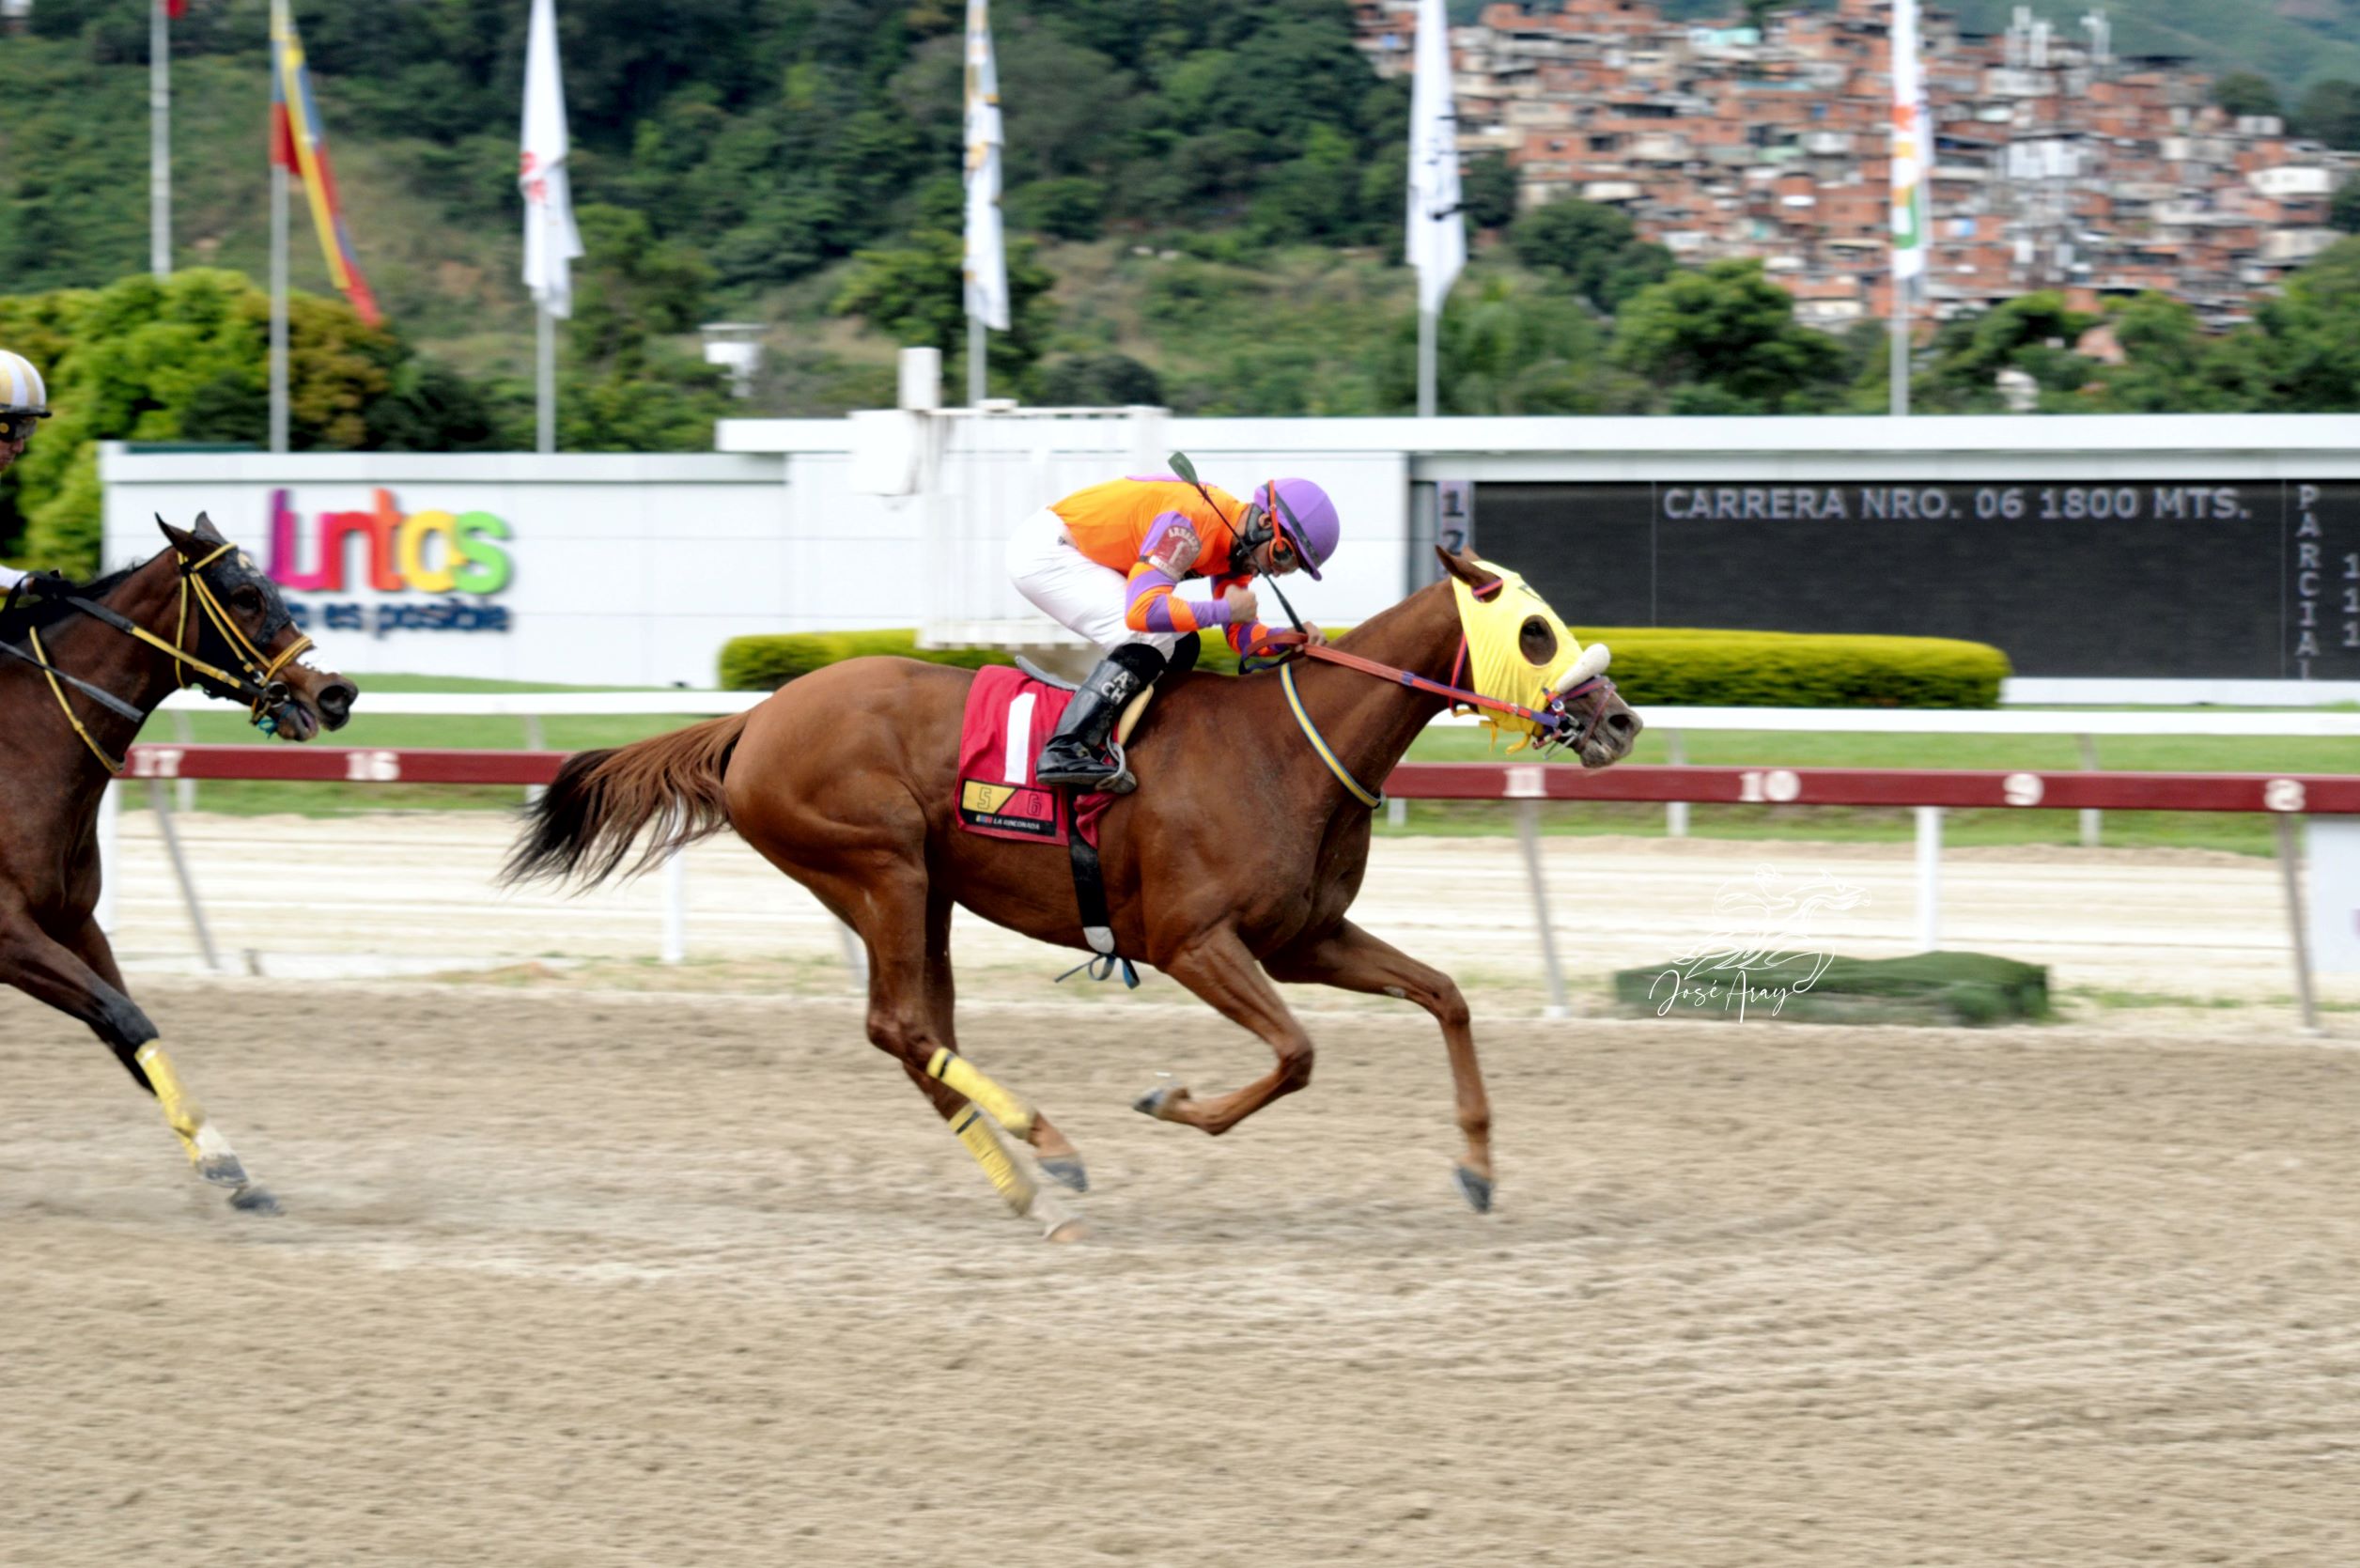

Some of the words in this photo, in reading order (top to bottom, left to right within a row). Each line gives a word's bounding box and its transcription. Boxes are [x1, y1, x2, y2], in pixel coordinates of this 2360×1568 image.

[1663, 487, 1849, 519] CARRERA
[1861, 487, 1962, 519] NRO.
[1975, 487, 2026, 520] 06
[2039, 487, 2141, 520] 1800
[2153, 487, 2252, 520] MTS.
[1101, 682, 1127, 706] CH
[1113, 671, 1129, 690] A
[1004, 691, 1036, 784] 1
[345, 751, 401, 782] 16
[977, 786, 992, 810] 5
[1739, 769, 1801, 802] 10
[2002, 772, 2044, 807] 9
[1027, 793, 1042, 816] 6
